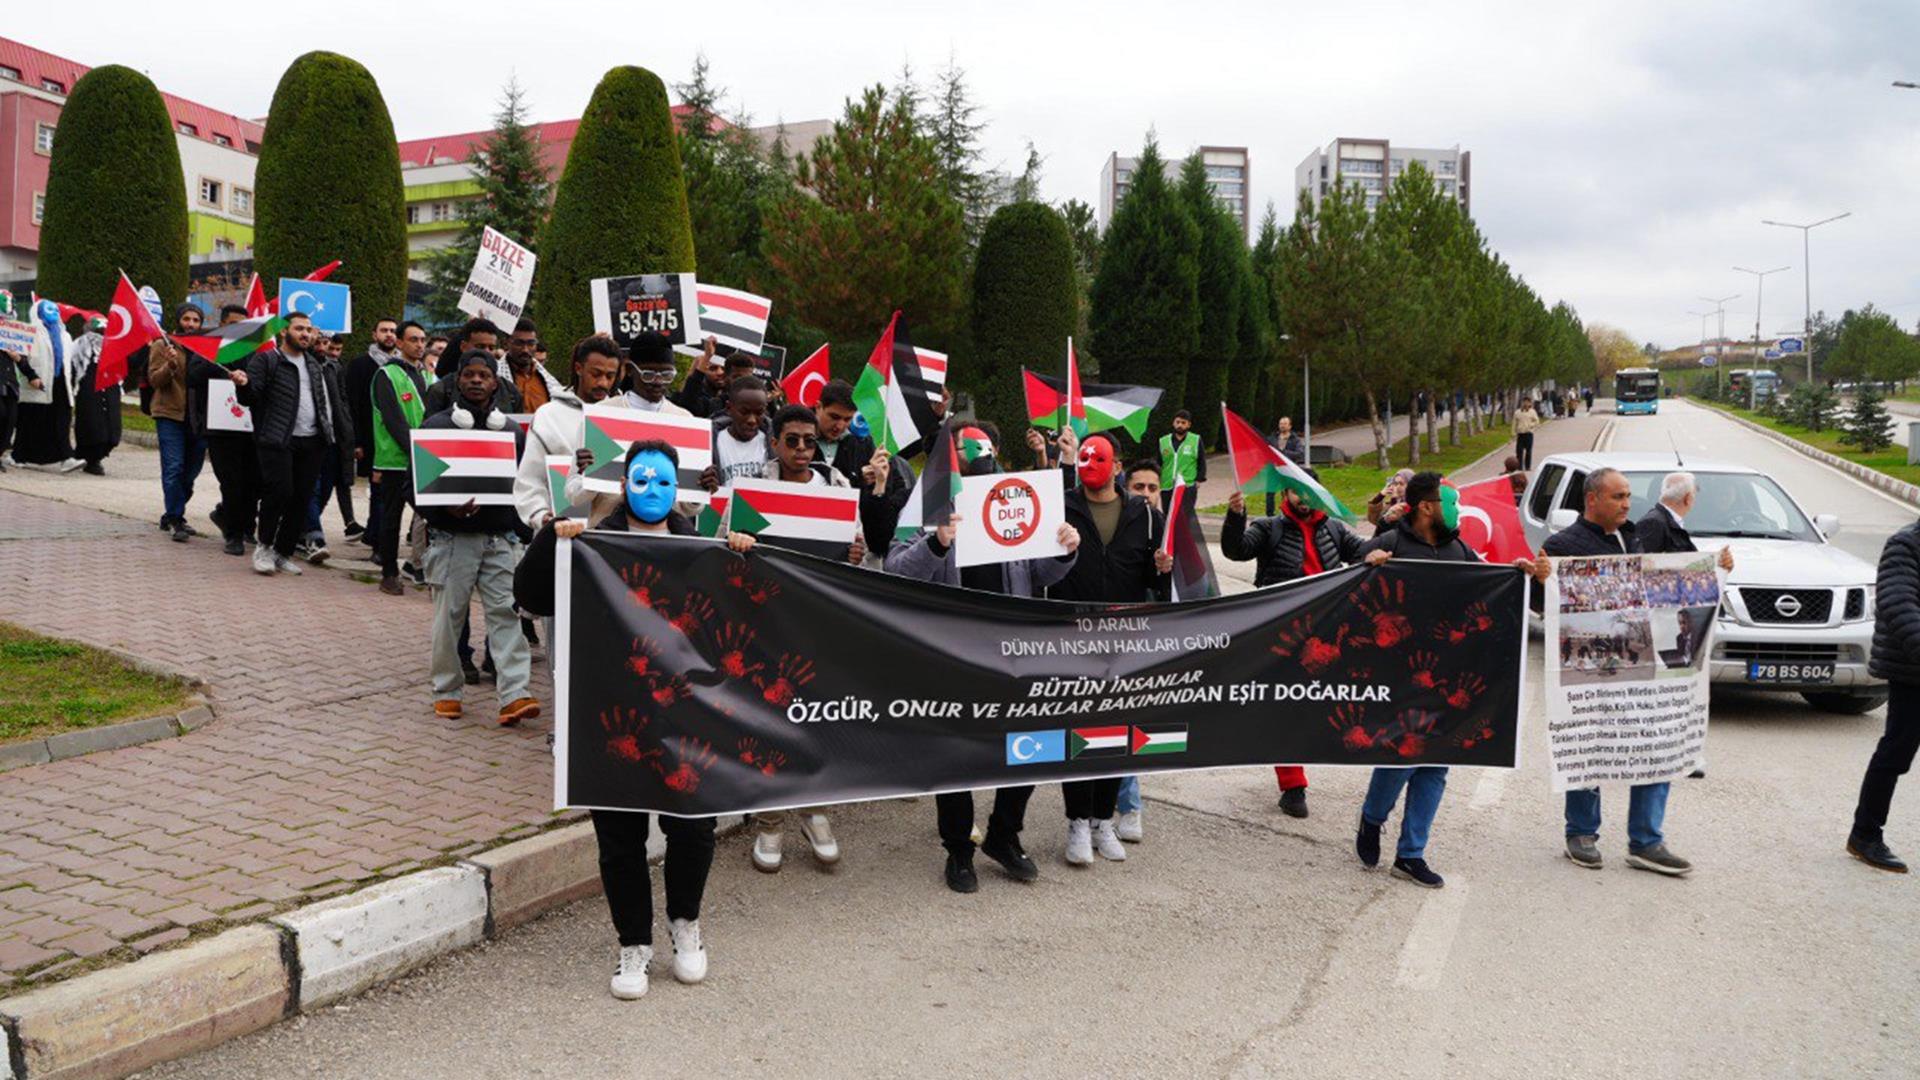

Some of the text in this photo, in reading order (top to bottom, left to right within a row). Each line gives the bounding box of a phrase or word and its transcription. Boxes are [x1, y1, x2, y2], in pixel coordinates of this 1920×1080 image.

[482, 229, 526, 269] GAZZE
[490, 254, 498, 268] 2
[500, 260, 513, 277] YIL
[619, 309, 678, 333] 53.475
[989, 485, 1033, 501] ZULME
[998, 508, 1026, 520] DUR
[1003, 528, 1022, 541] DE
[1075, 617, 1151, 632] 10 ARALIK
[1001, 632, 1231, 656] DÜNYA İNSAN HAKLARI GÜNÜ
[1028, 669, 1204, 697] BÜTÜN İNSANLAR
[1757, 665, 1832, 678] 78 BS 604
[787, 680, 1392, 723] ÖZGÜR, ONUR VE HAKLAR BAKIMINDAN EŞİT DOĞARLAR
